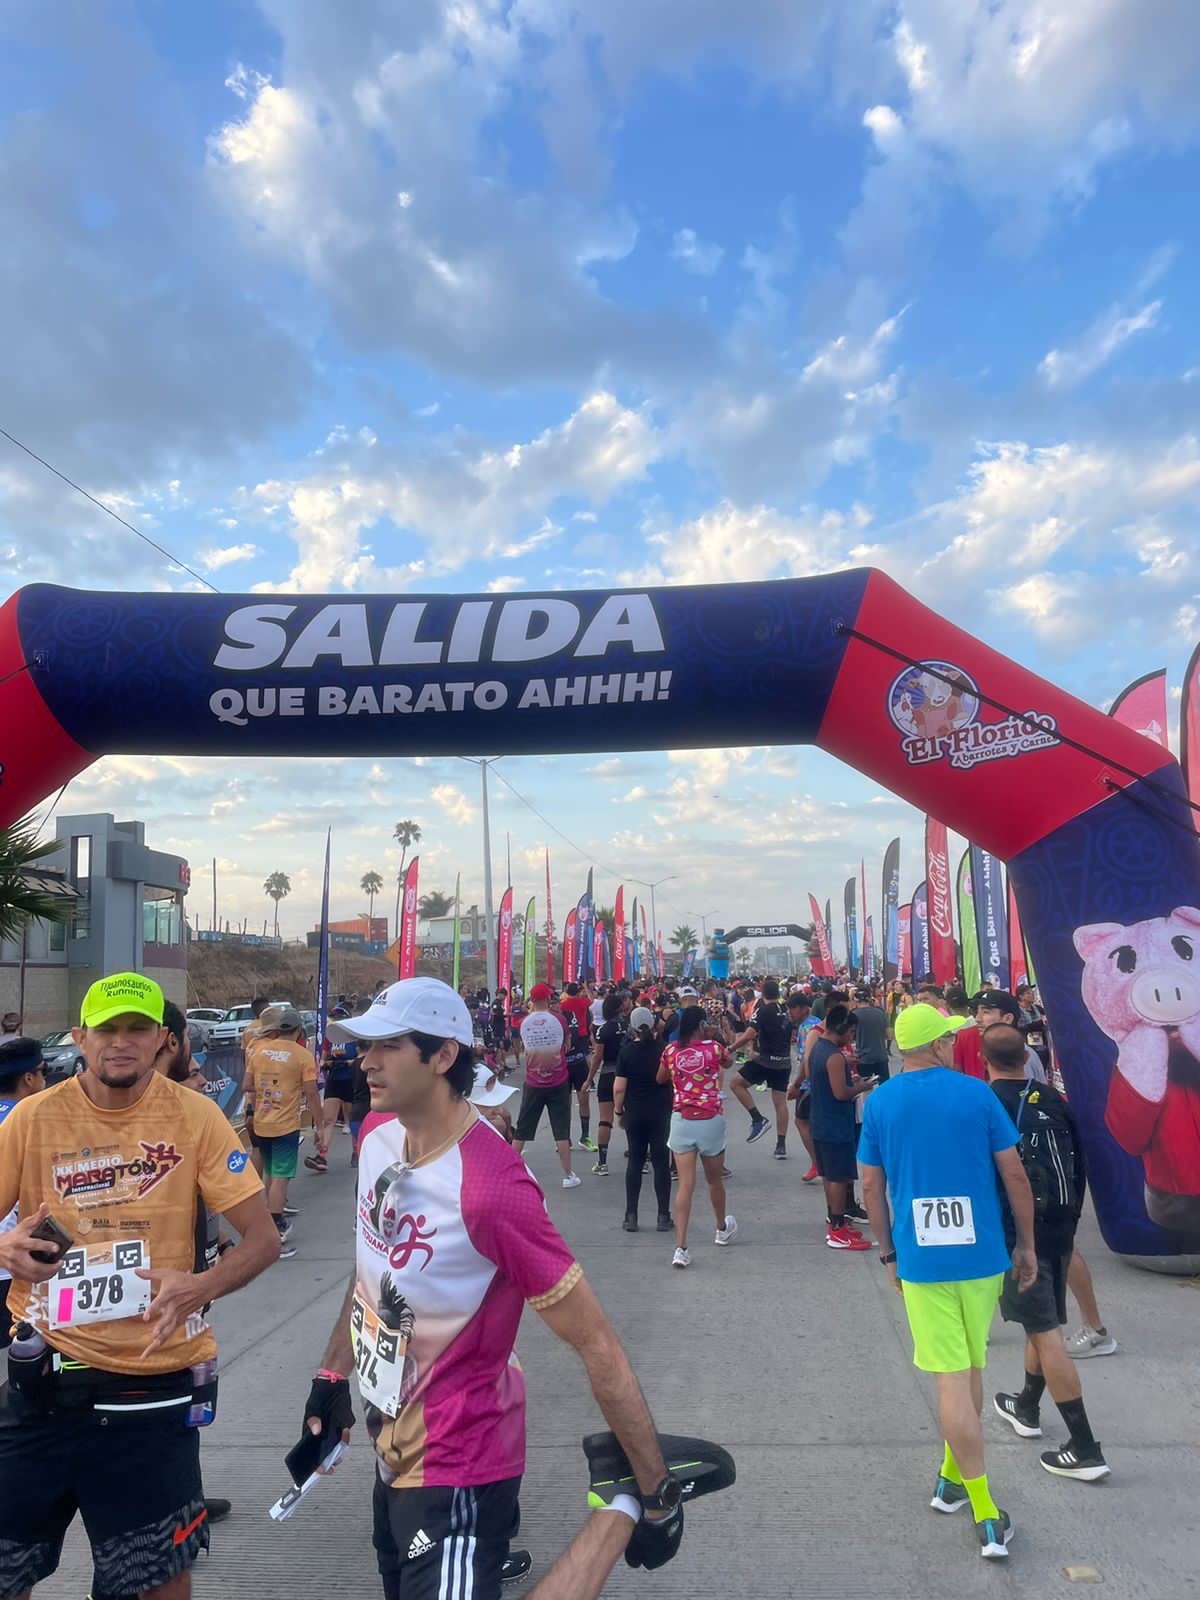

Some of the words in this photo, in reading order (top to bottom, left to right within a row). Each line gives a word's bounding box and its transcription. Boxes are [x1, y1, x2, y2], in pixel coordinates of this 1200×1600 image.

[212, 593, 666, 671] SALIDA
[209, 686, 305, 727] QUE
[317, 681, 509, 716] BARATO
[516, 670, 672, 709] AHHH!
[905, 736, 939, 761] El
[946, 713, 1054, 753] Florido
[955, 745, 1007, 766] Abarrotes
[1010, 743, 1018, 755] y
[746, 926, 788, 936] SALIDA
[986, 940, 1000, 967] Que
[77, 1157, 120, 1172] MEDIO
[921, 1200, 965, 1229] 760
[77, 1274, 124, 1310] 378
[355, 1337, 378, 1390] 374
